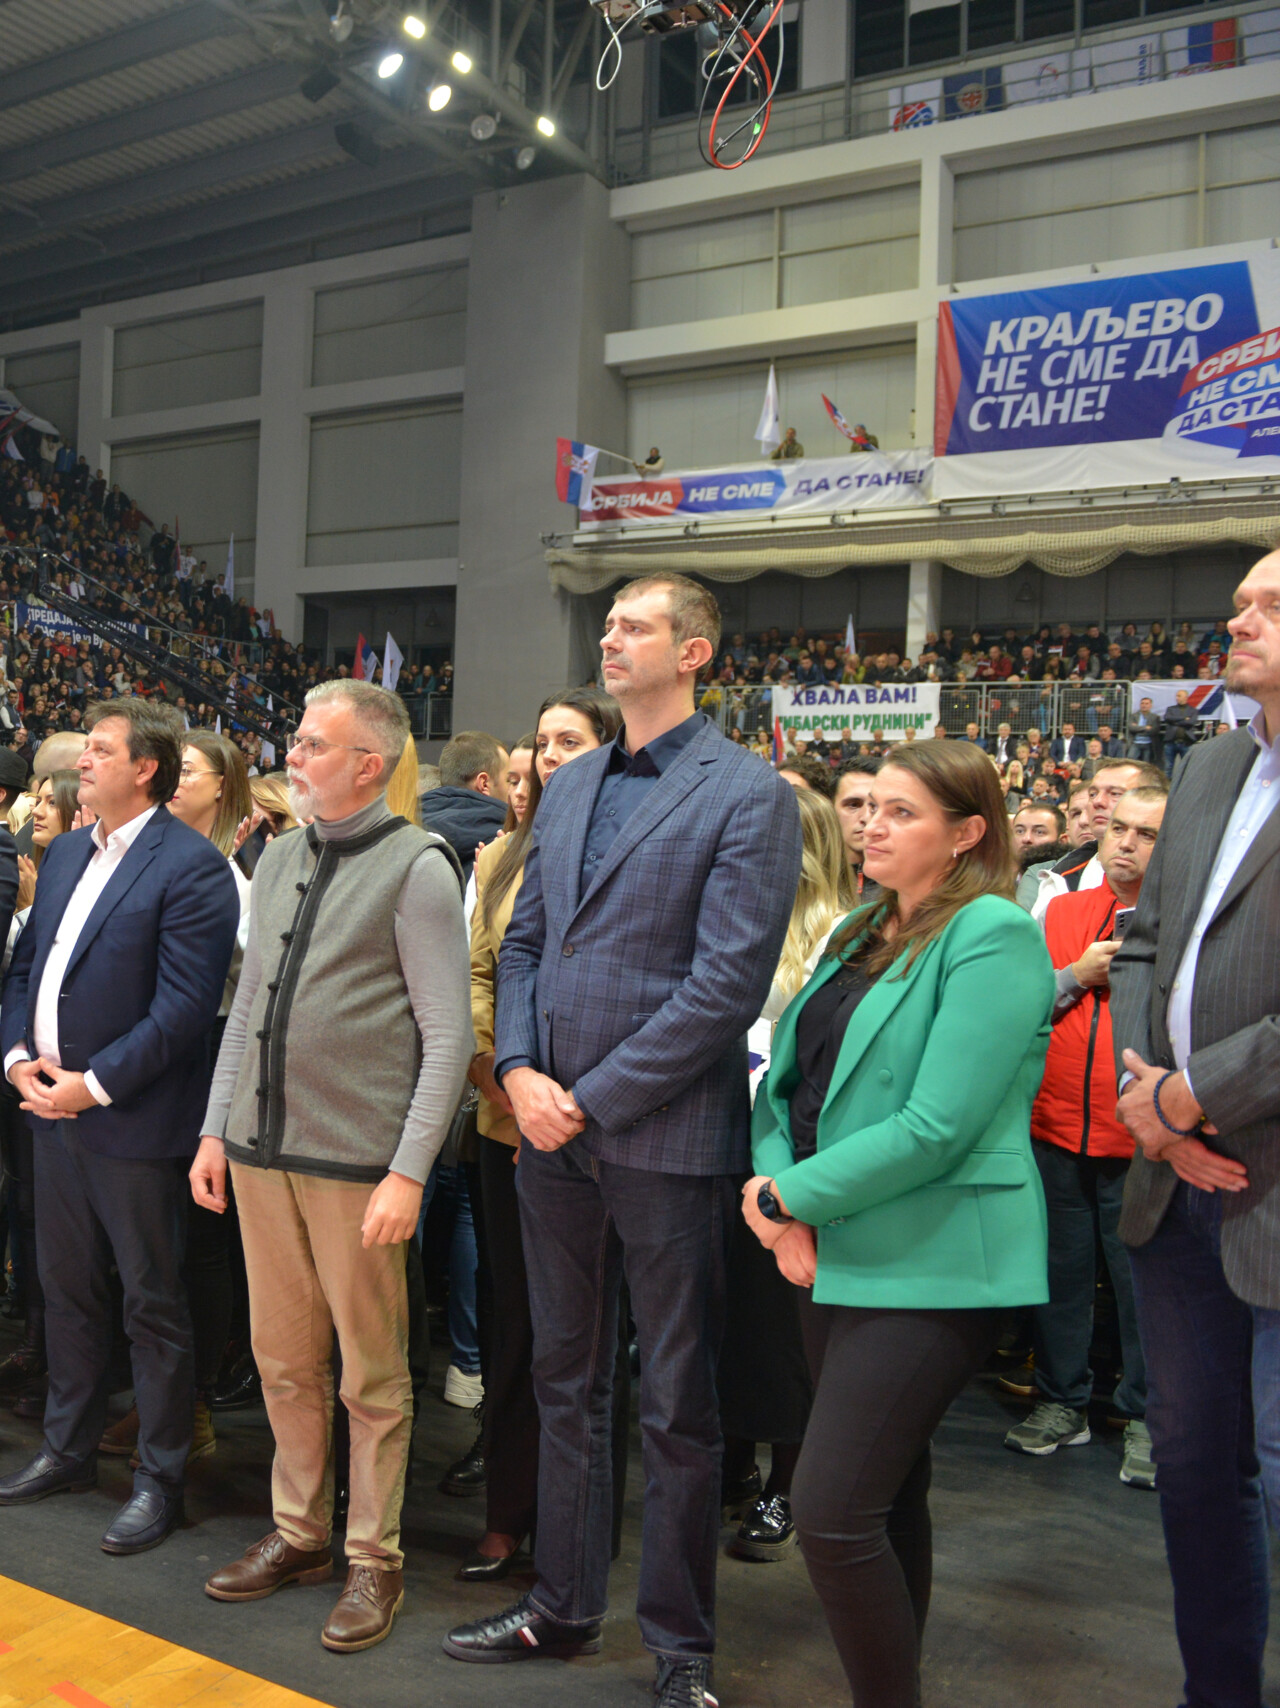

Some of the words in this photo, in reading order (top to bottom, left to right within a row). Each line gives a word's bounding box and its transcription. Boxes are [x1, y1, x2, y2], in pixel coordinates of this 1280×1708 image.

[983, 292, 1224, 356] КРАЉЕВО
[975, 354, 1032, 394] НЕ
[1040, 343, 1133, 388] СМЕ
[1133, 335, 1200, 381] ДА
[1196, 331, 1280, 382] СРБИ
[968, 384, 1111, 432] СТАНЕ!
[1187, 378, 1228, 409] НЕ
[1230, 363, 1280, 394] СМ
[1176, 408, 1212, 435] ДА
[1218, 392, 1280, 421] СТА
[591, 490, 674, 511] СРБИЈА
[688, 487, 719, 503] НЕ
[722, 481, 775, 500] СМЕ
[793, 478, 829, 496] ДА
[836, 469, 924, 490] СТАНЕ!
[27, 607, 74, 626] ПРЕДАЈА
[790, 688, 860, 706] ХВАЛА
[865, 687, 917, 704] ВАМ!
